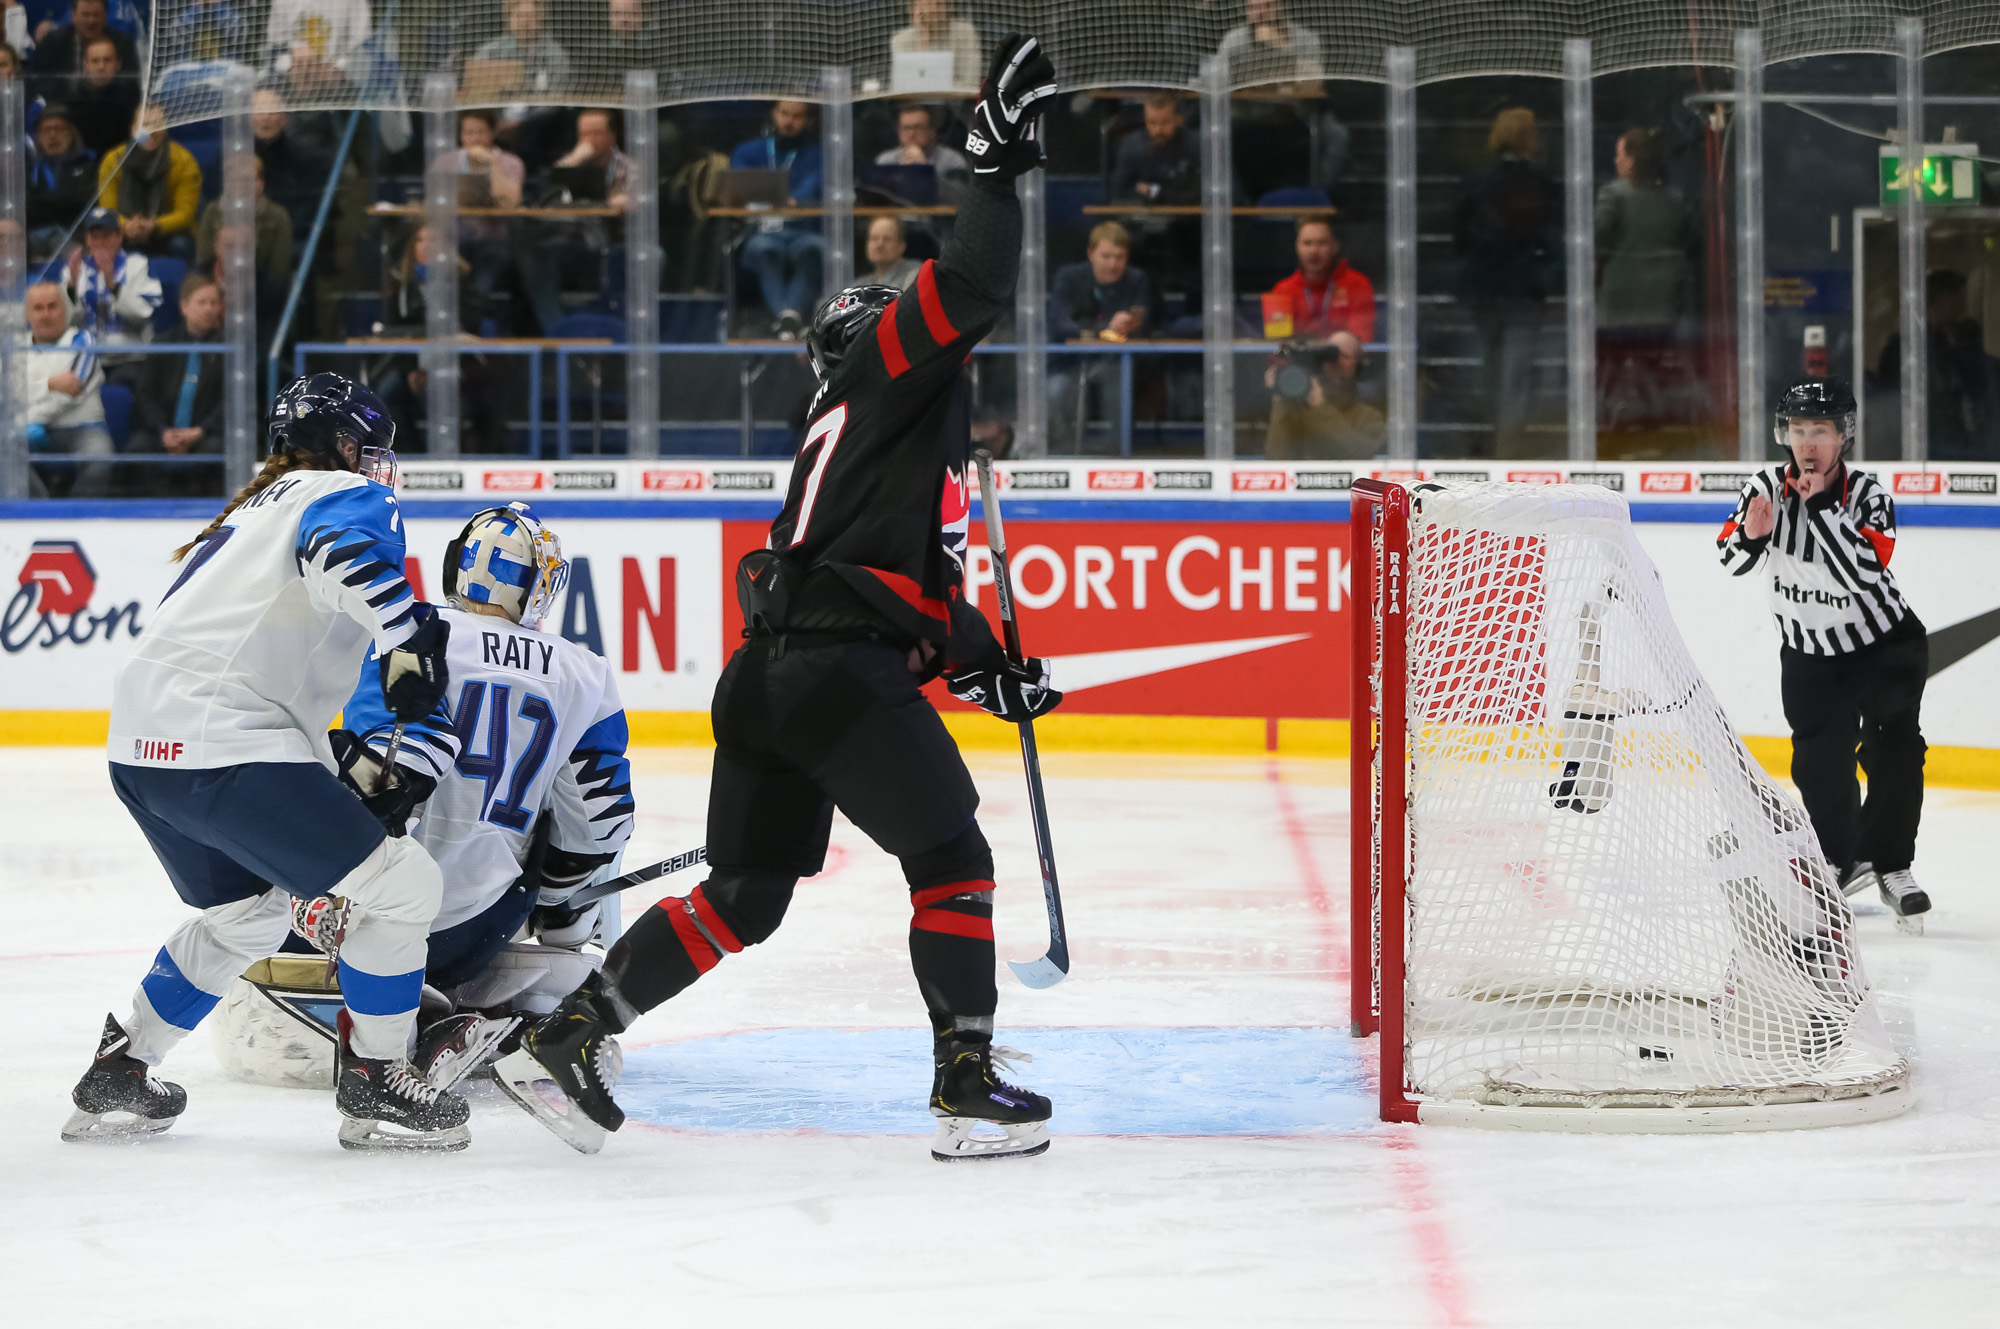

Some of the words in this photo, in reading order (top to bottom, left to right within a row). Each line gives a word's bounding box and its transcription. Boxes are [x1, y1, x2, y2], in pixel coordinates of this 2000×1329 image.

[558, 473, 614, 488] DIRECT
[717, 473, 772, 488] DIRECT
[1014, 473, 1068, 488] DIRECT
[1156, 473, 1210, 488] DIRECT
[1235, 473, 1284, 490] TSN
[1299, 473, 1350, 488] DIRECT
[1703, 474, 1749, 491] DIREC
[1951, 475, 1996, 491] DIRECT
[1869, 510, 1888, 527] 24
[1389, 552, 1401, 614] RAITA
[1774, 576, 1850, 610] intrum
[482, 631, 554, 675] RATY
[143, 740, 184, 761] IIHF
[454, 680, 559, 834] 41
[330, 945, 339, 962] CCM
